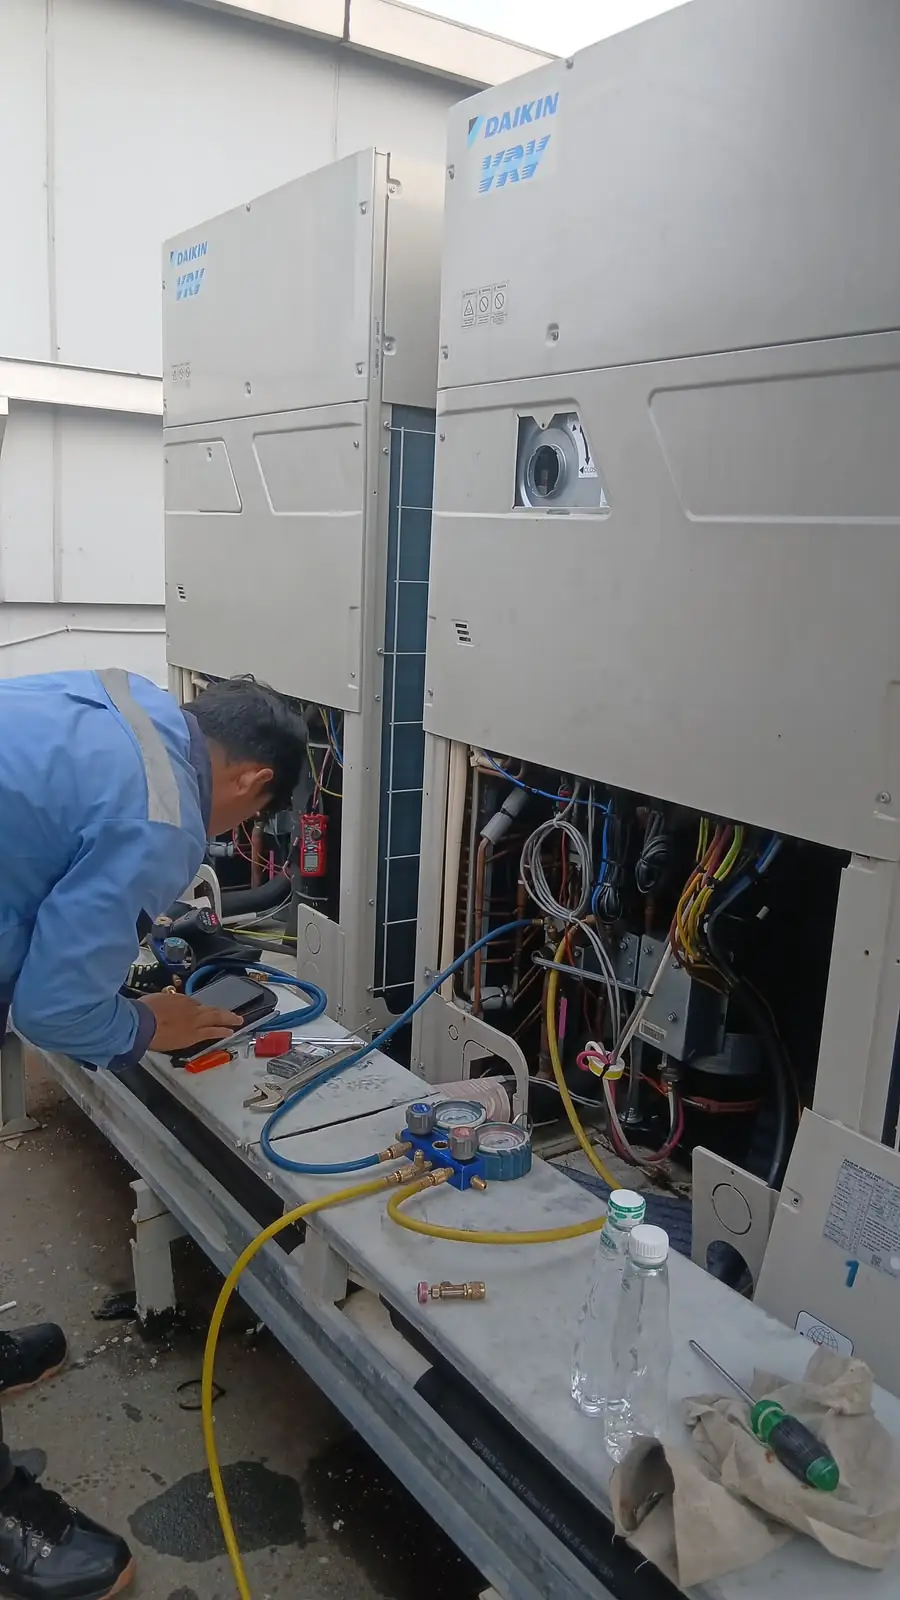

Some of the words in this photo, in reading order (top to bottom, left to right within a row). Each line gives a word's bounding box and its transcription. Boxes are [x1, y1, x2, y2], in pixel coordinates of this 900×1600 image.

[484, 91, 560, 139] DAIKIN
[477, 134, 552, 194] VRV
[176, 240, 208, 266] DAIKIN
[175, 267, 206, 301] VRV
